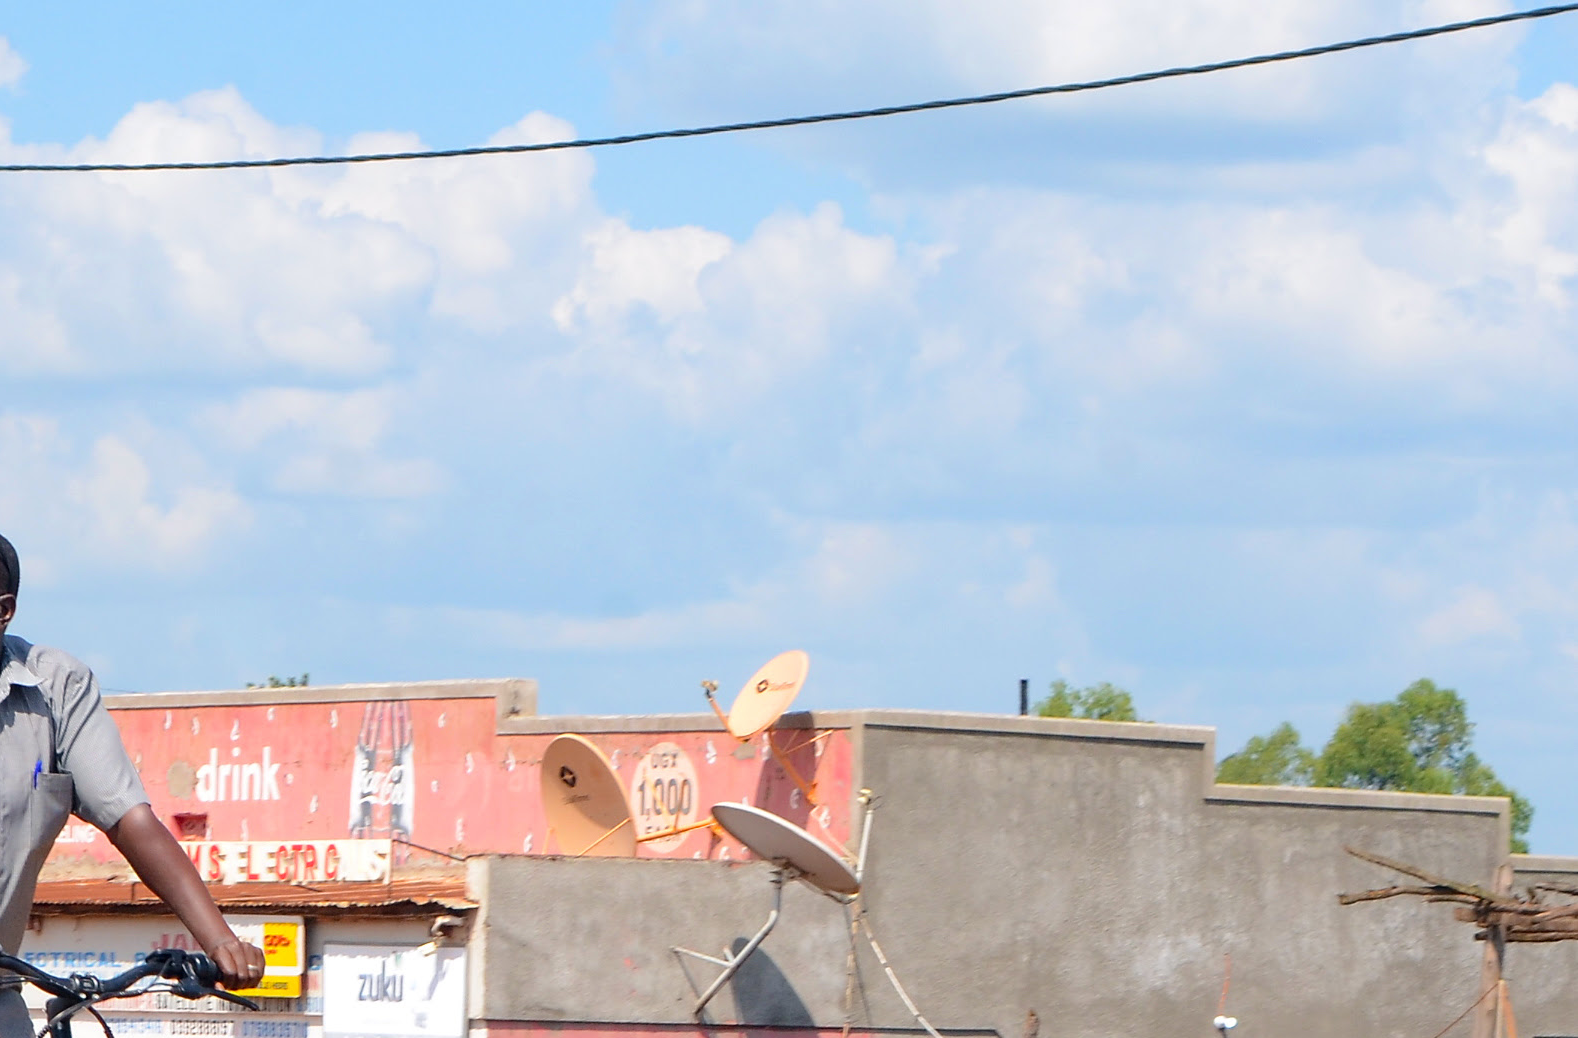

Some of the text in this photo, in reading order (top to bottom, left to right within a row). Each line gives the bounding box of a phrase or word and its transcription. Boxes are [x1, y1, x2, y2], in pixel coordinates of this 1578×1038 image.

[196, 746, 281, 802] drink
[651, 752, 678, 769] UGX
[638, 778, 692, 821] 1,000
[358, 960, 404, 1002] zuku
